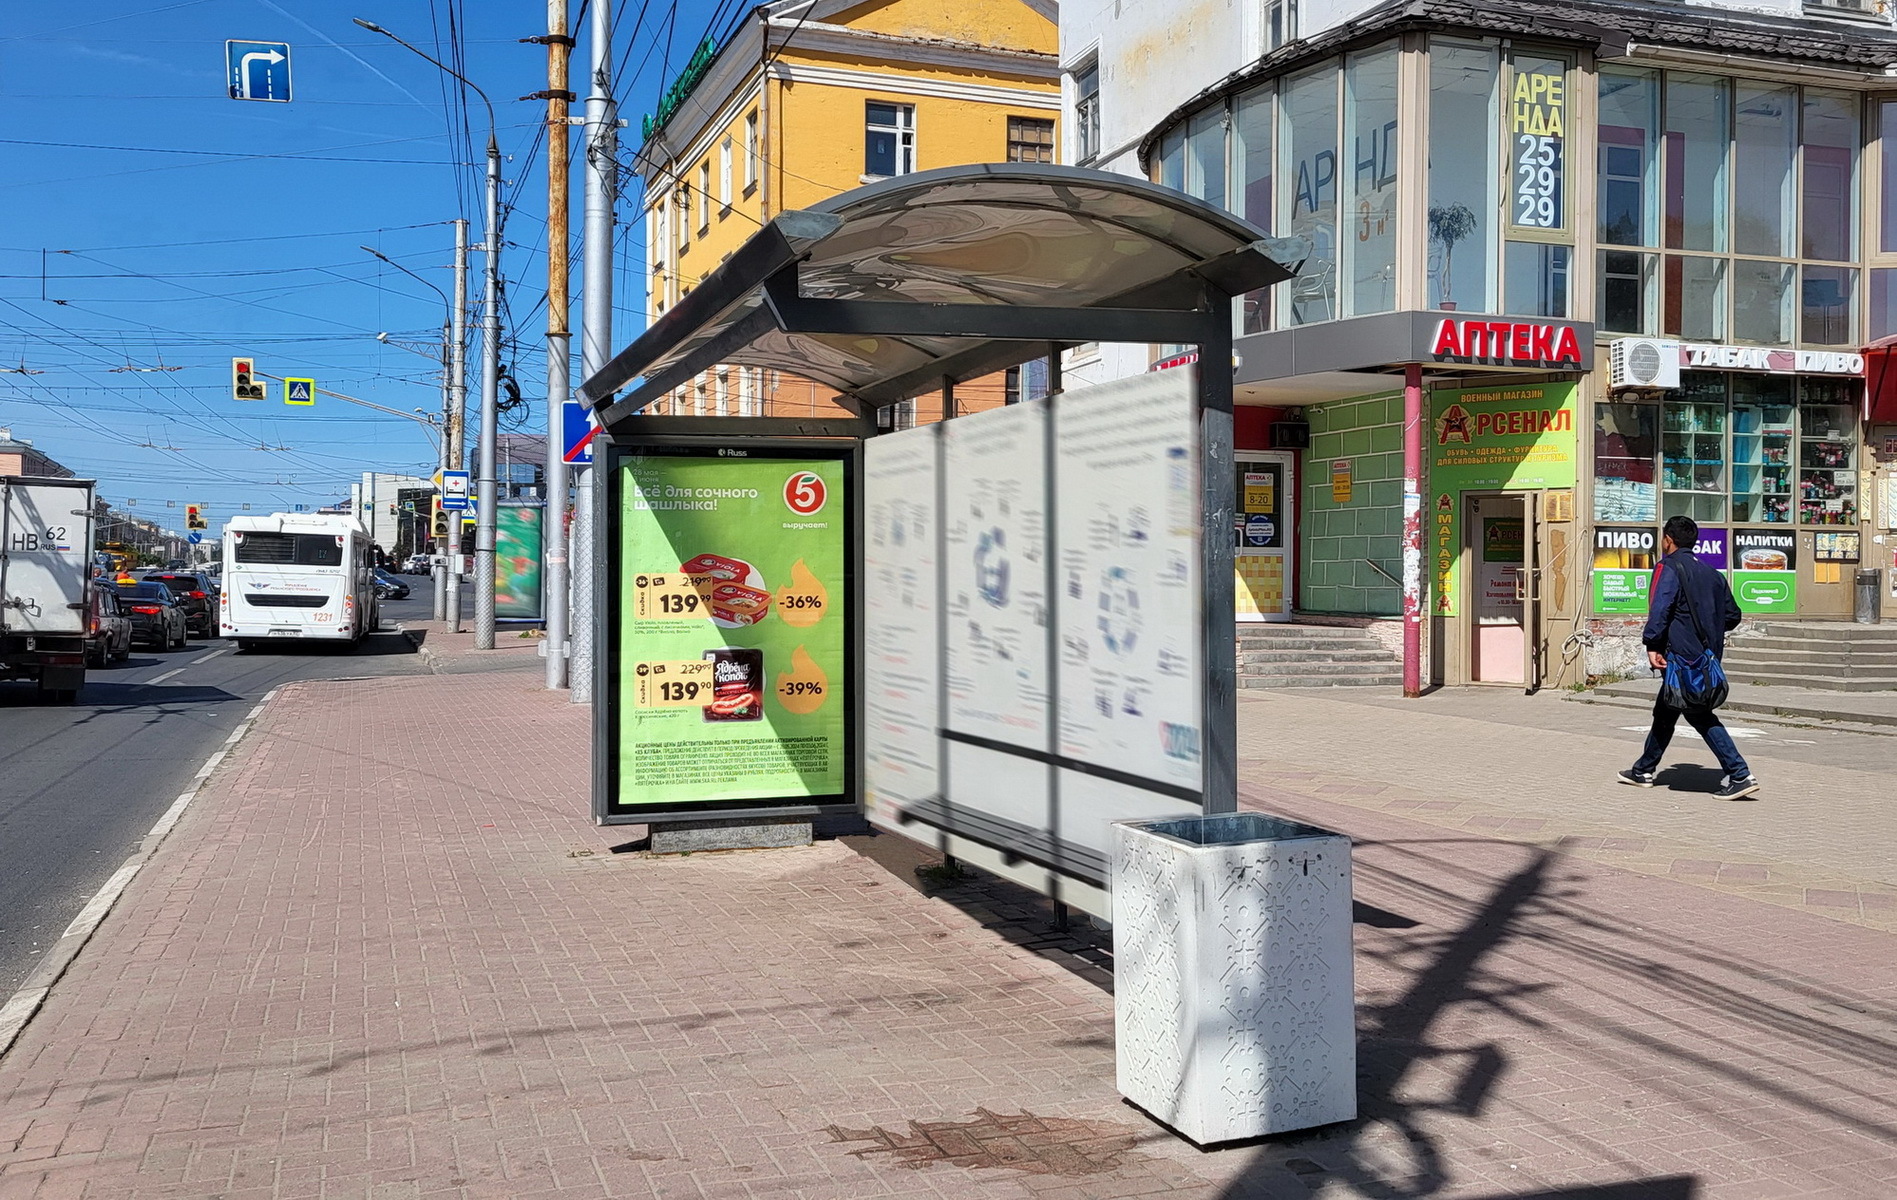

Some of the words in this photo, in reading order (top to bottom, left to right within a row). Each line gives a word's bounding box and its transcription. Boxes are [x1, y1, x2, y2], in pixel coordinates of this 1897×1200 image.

[1514, 72, 1562, 106] АРЕ
[1514, 103, 1563, 137] НДА
[1519, 134, 1554, 166] 25
[1518, 164, 1554, 196] 29
[1518, 195, 1554, 227] 29
[1432, 319, 1582, 362] АПТЕКА
[1686, 345, 1772, 370] ТАБАК
[1796, 350, 1864, 374] ПИВО
[1461, 391, 1500, 403] ВОЕННЫЙ
[1504, 390, 1543, 400] МАГАЗИН
[1476, 448, 1506, 456] ОДЕЖДА
[1490, 456, 1524, 464] СТРУКТУР
[634, 484, 660, 498] Всё
[665, 485, 692, 498] для
[695, 488, 758, 498] сочного
[634, 499, 718, 510] шашлыка!
[1249, 496, 1269, 504] 8-20
[46, 526, 66, 540] 62
[1598, 530, 1654, 550] ПИВО
[1692, 540, 1722, 554] БАК
[1736, 535, 1794, 547] НАПИТКИ
[1436, 514, 1452, 592] МАГАЗИН
[716, 562, 741, 574] VIOLA
[736, 590, 763, 602] VIOLA
[779, 596, 822, 608] -36%
[660, 594, 698, 613] 139
[313, 613, 332, 622] 1231
[660, 682, 699, 700] 139
[779, 682, 822, 695] -39%
